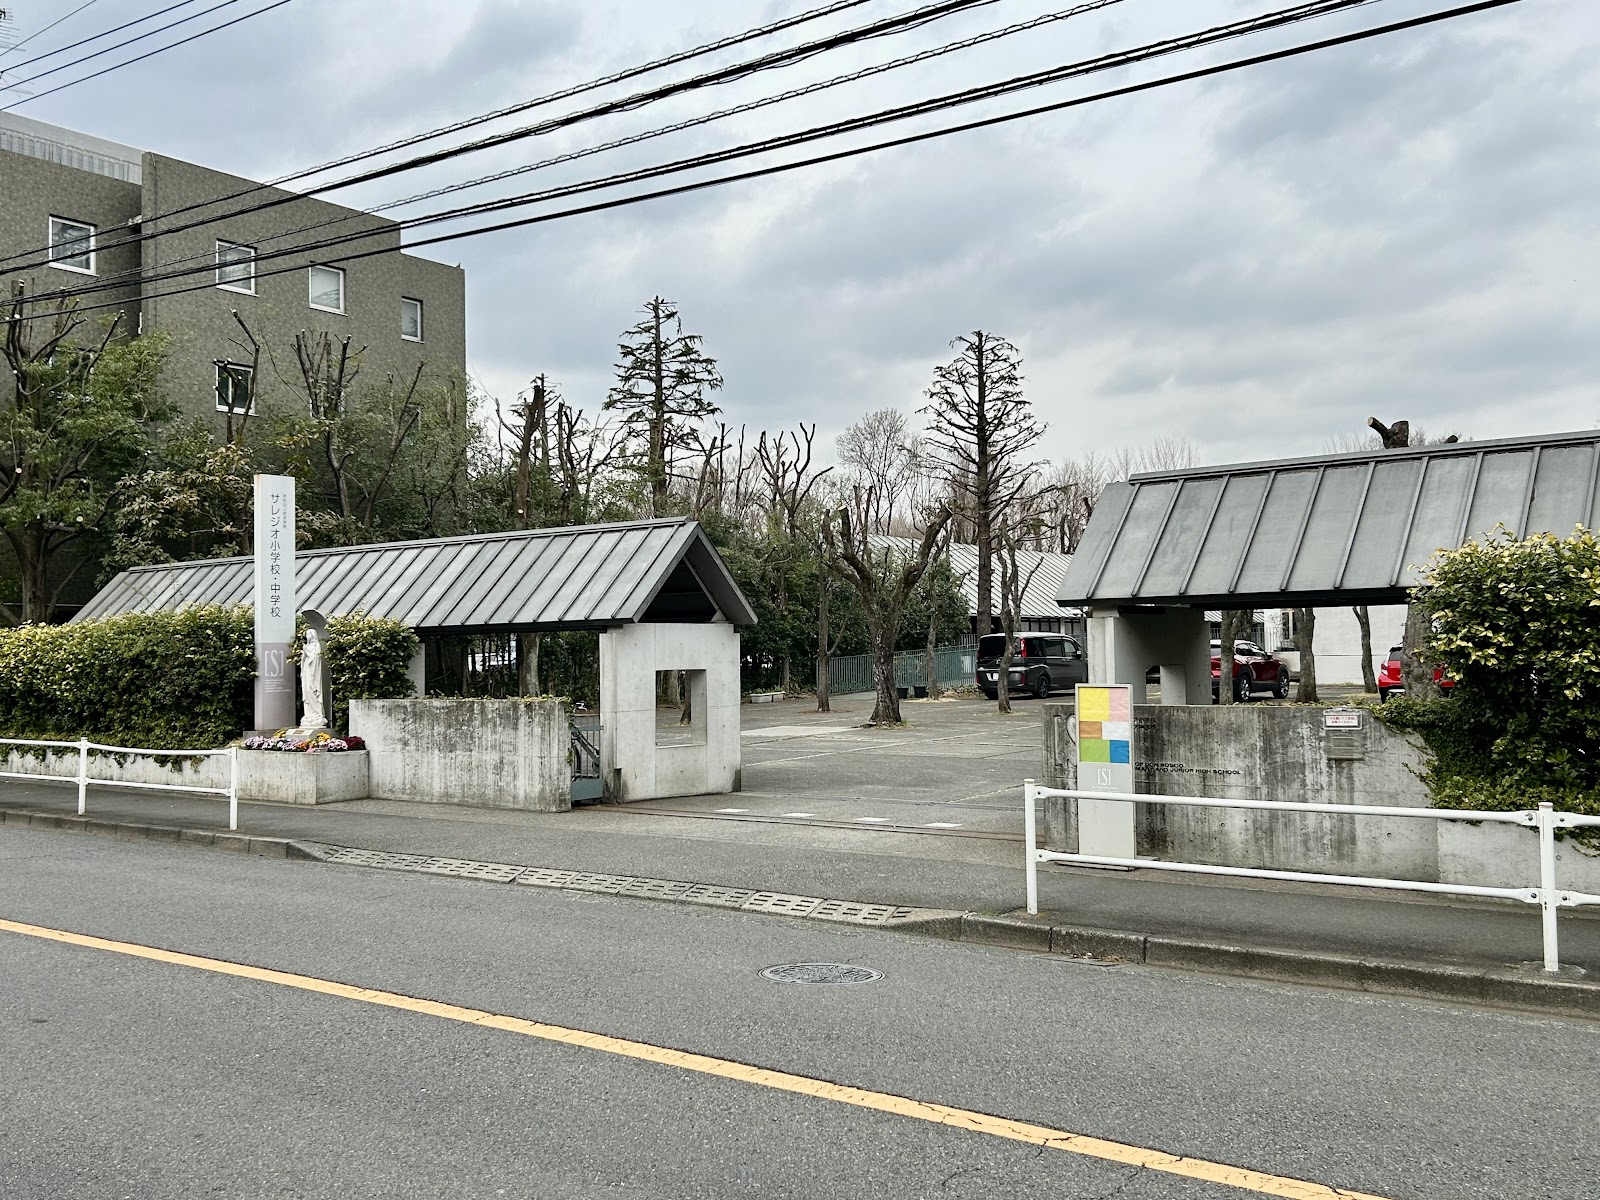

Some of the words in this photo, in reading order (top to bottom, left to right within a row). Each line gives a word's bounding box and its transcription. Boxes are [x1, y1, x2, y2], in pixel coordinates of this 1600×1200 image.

[270, 493, 281, 618] サレジオ小学校・中学校
